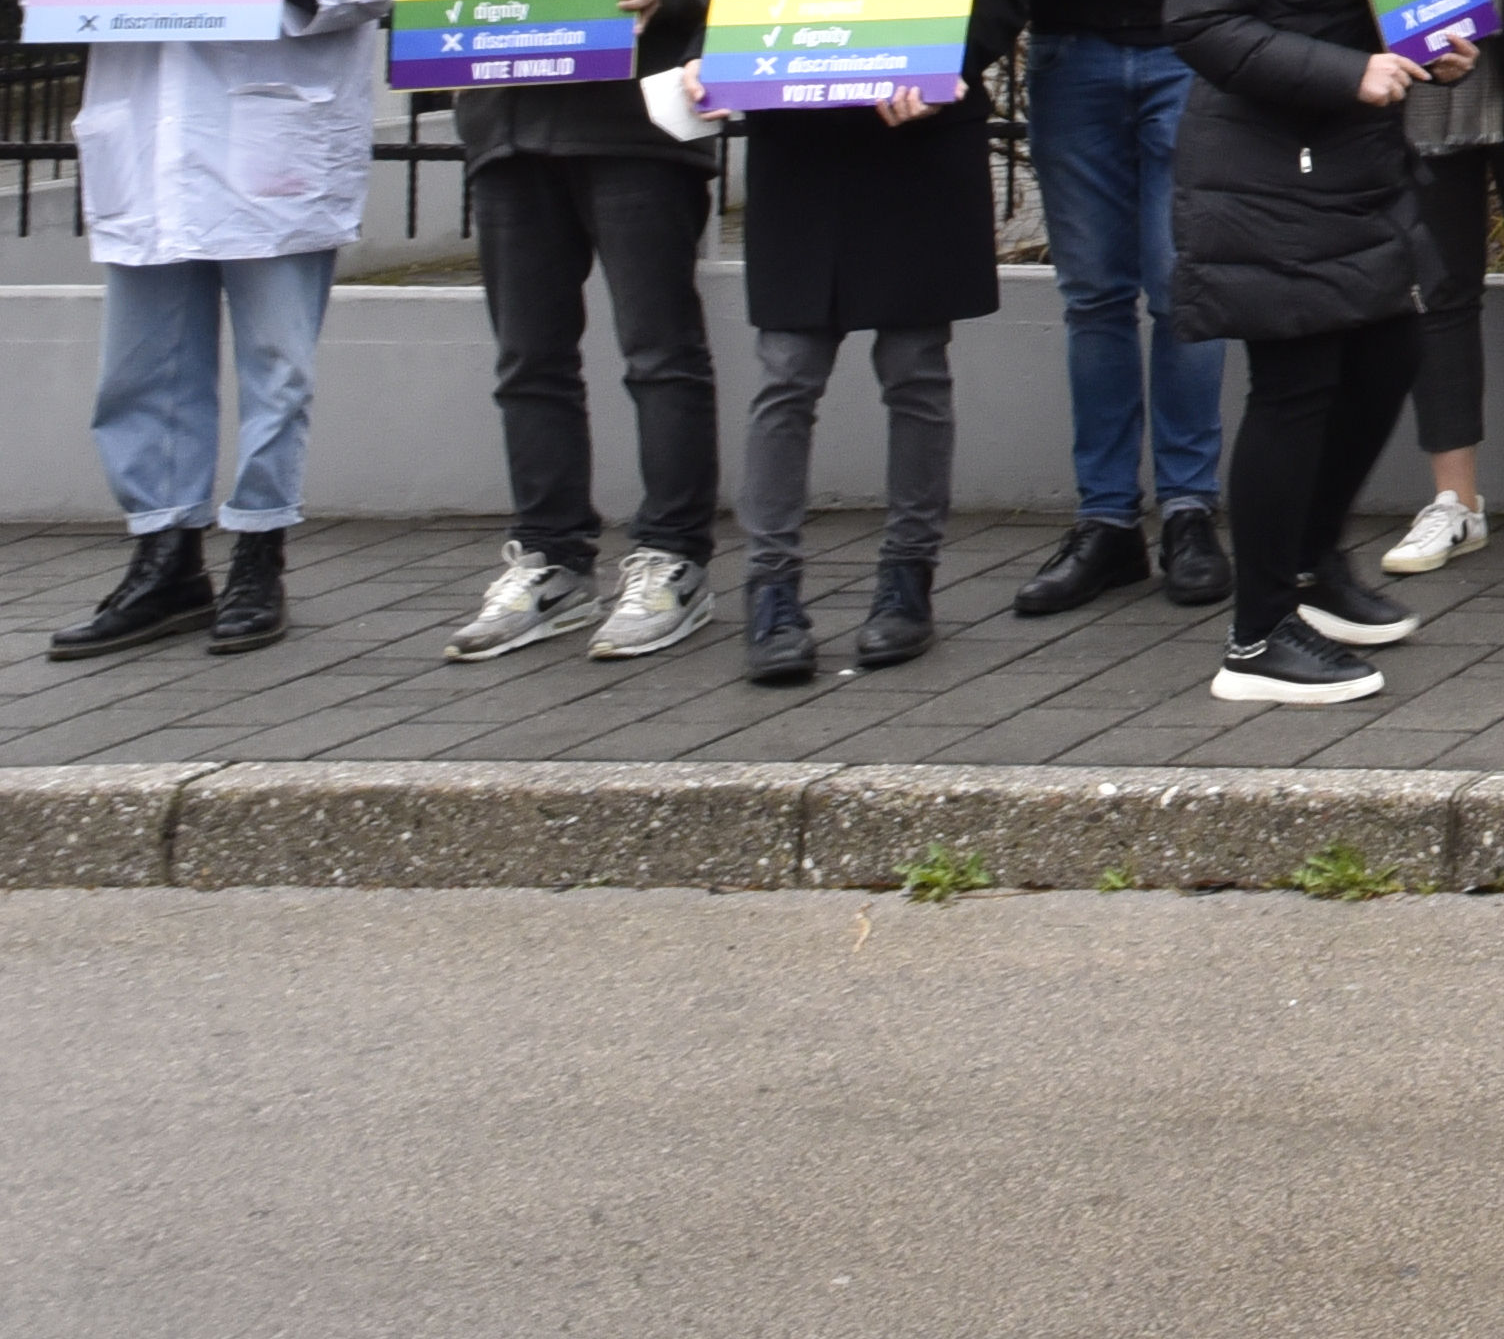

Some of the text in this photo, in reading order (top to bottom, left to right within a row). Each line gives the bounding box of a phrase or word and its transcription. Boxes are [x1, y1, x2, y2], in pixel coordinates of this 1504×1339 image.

[110, 13, 226, 29] discrimination
[473, 1, 530, 22] dignity
[472, 28, 586, 50] discrimination
[792, 26, 852, 47] dignity
[471, 57, 576, 80] VOTE INVALID
[787, 53, 909, 74] discrimination
[782, 81, 894, 102] VOTE INVALID
